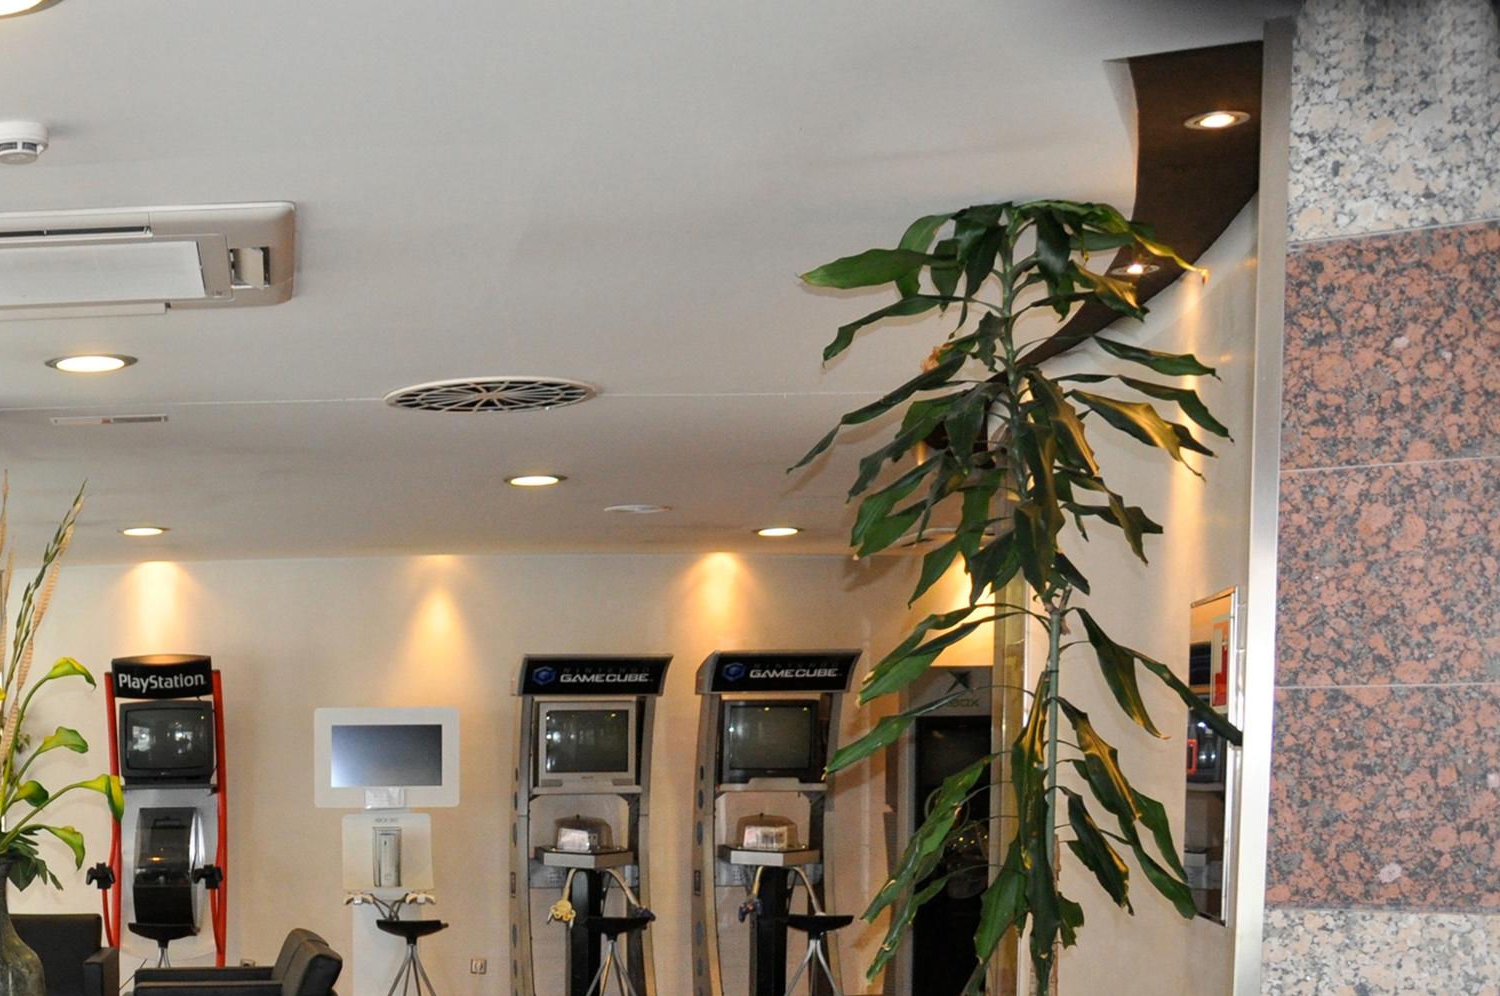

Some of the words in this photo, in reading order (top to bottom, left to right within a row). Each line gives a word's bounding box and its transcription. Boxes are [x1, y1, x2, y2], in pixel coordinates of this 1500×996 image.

[560, 673, 649, 682] GAMECUBE
[749, 668, 838, 678] GAMECUBE
[118, 673, 205, 693] PlayStation
